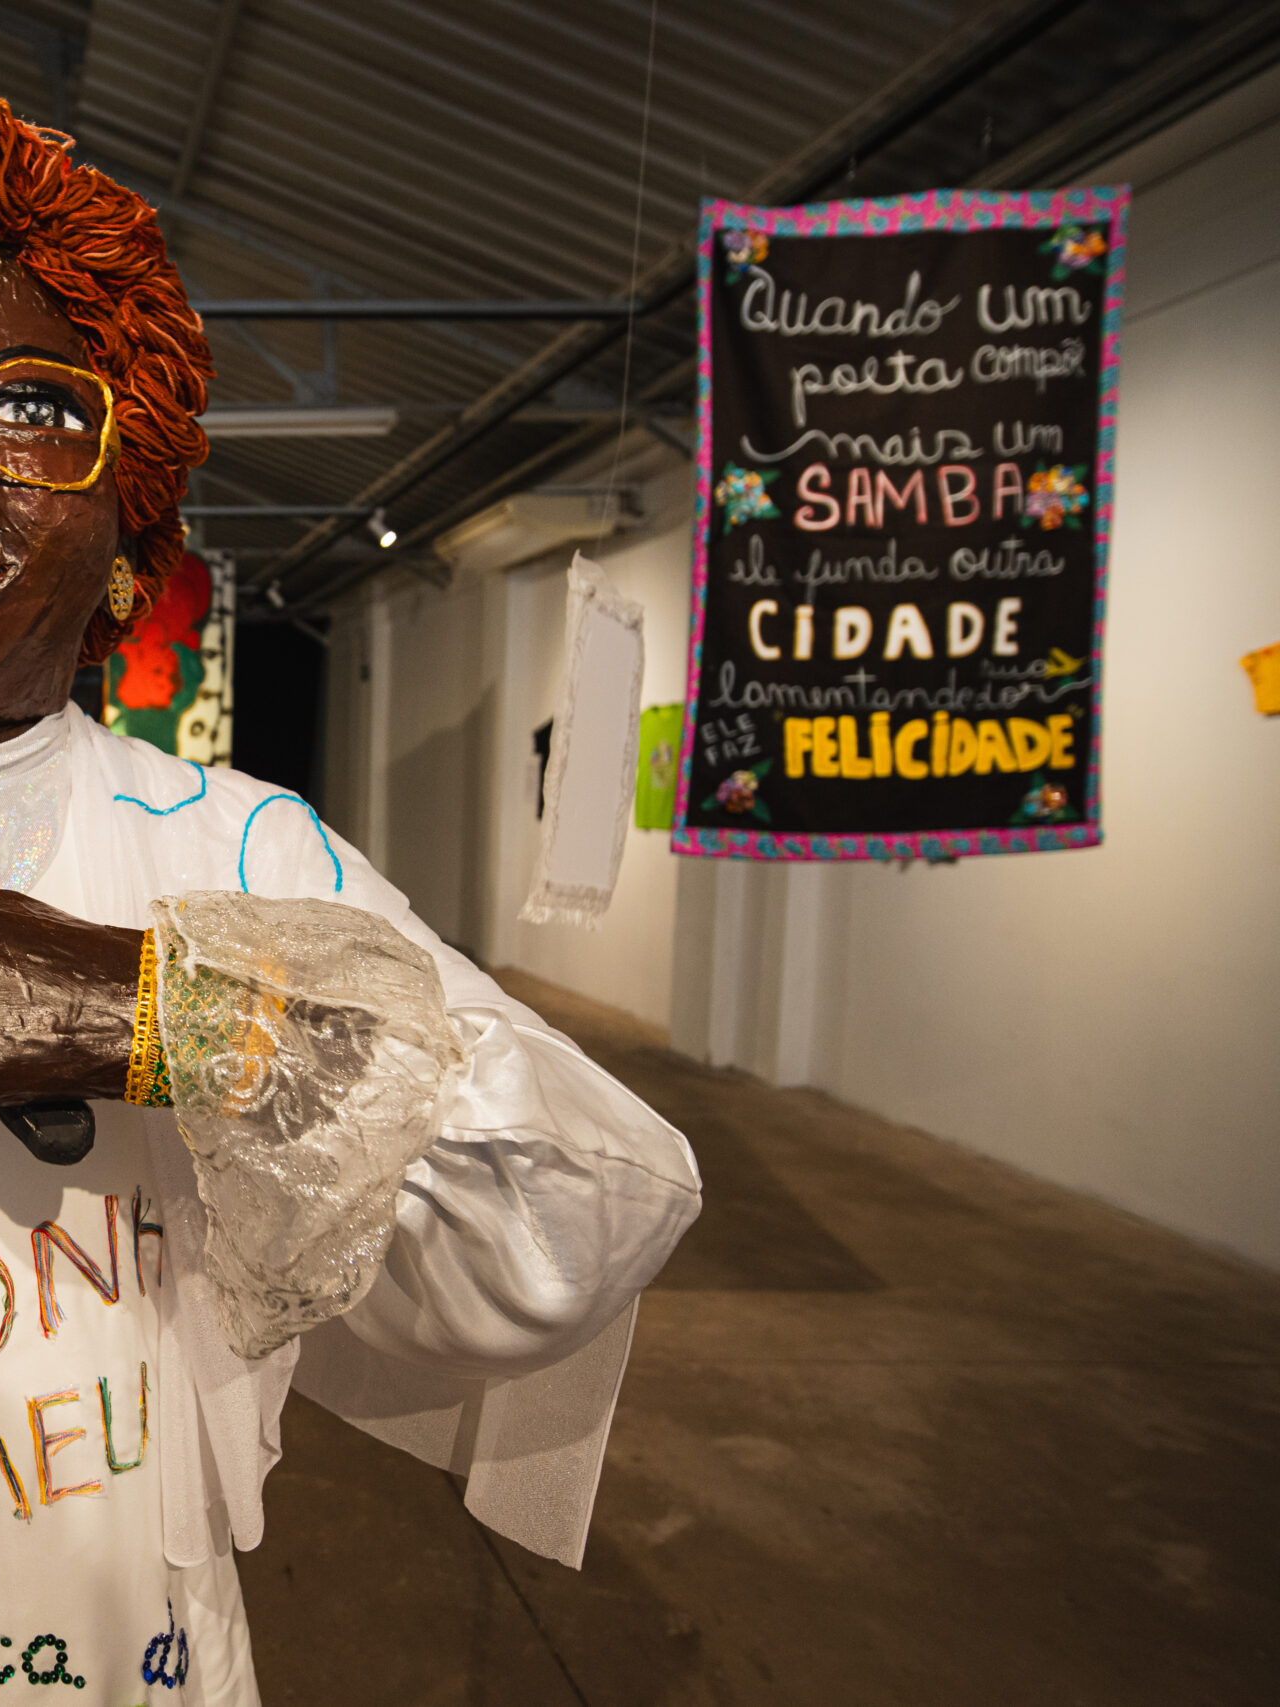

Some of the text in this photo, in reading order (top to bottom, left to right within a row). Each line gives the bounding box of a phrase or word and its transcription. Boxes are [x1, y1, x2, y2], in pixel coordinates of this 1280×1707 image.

[740, 265, 1093, 337] Quando um
[790, 350, 964, 428] poeta
[740, 420, 1064, 466] mais um
[793, 462, 1023, 532] SAMBA
[948, 533, 1066, 580] outra
[747, 596, 1022, 662] CIDADE
[700, 712, 756, 745] ELE
[782, 710, 1077, 780] FELICIDADE
